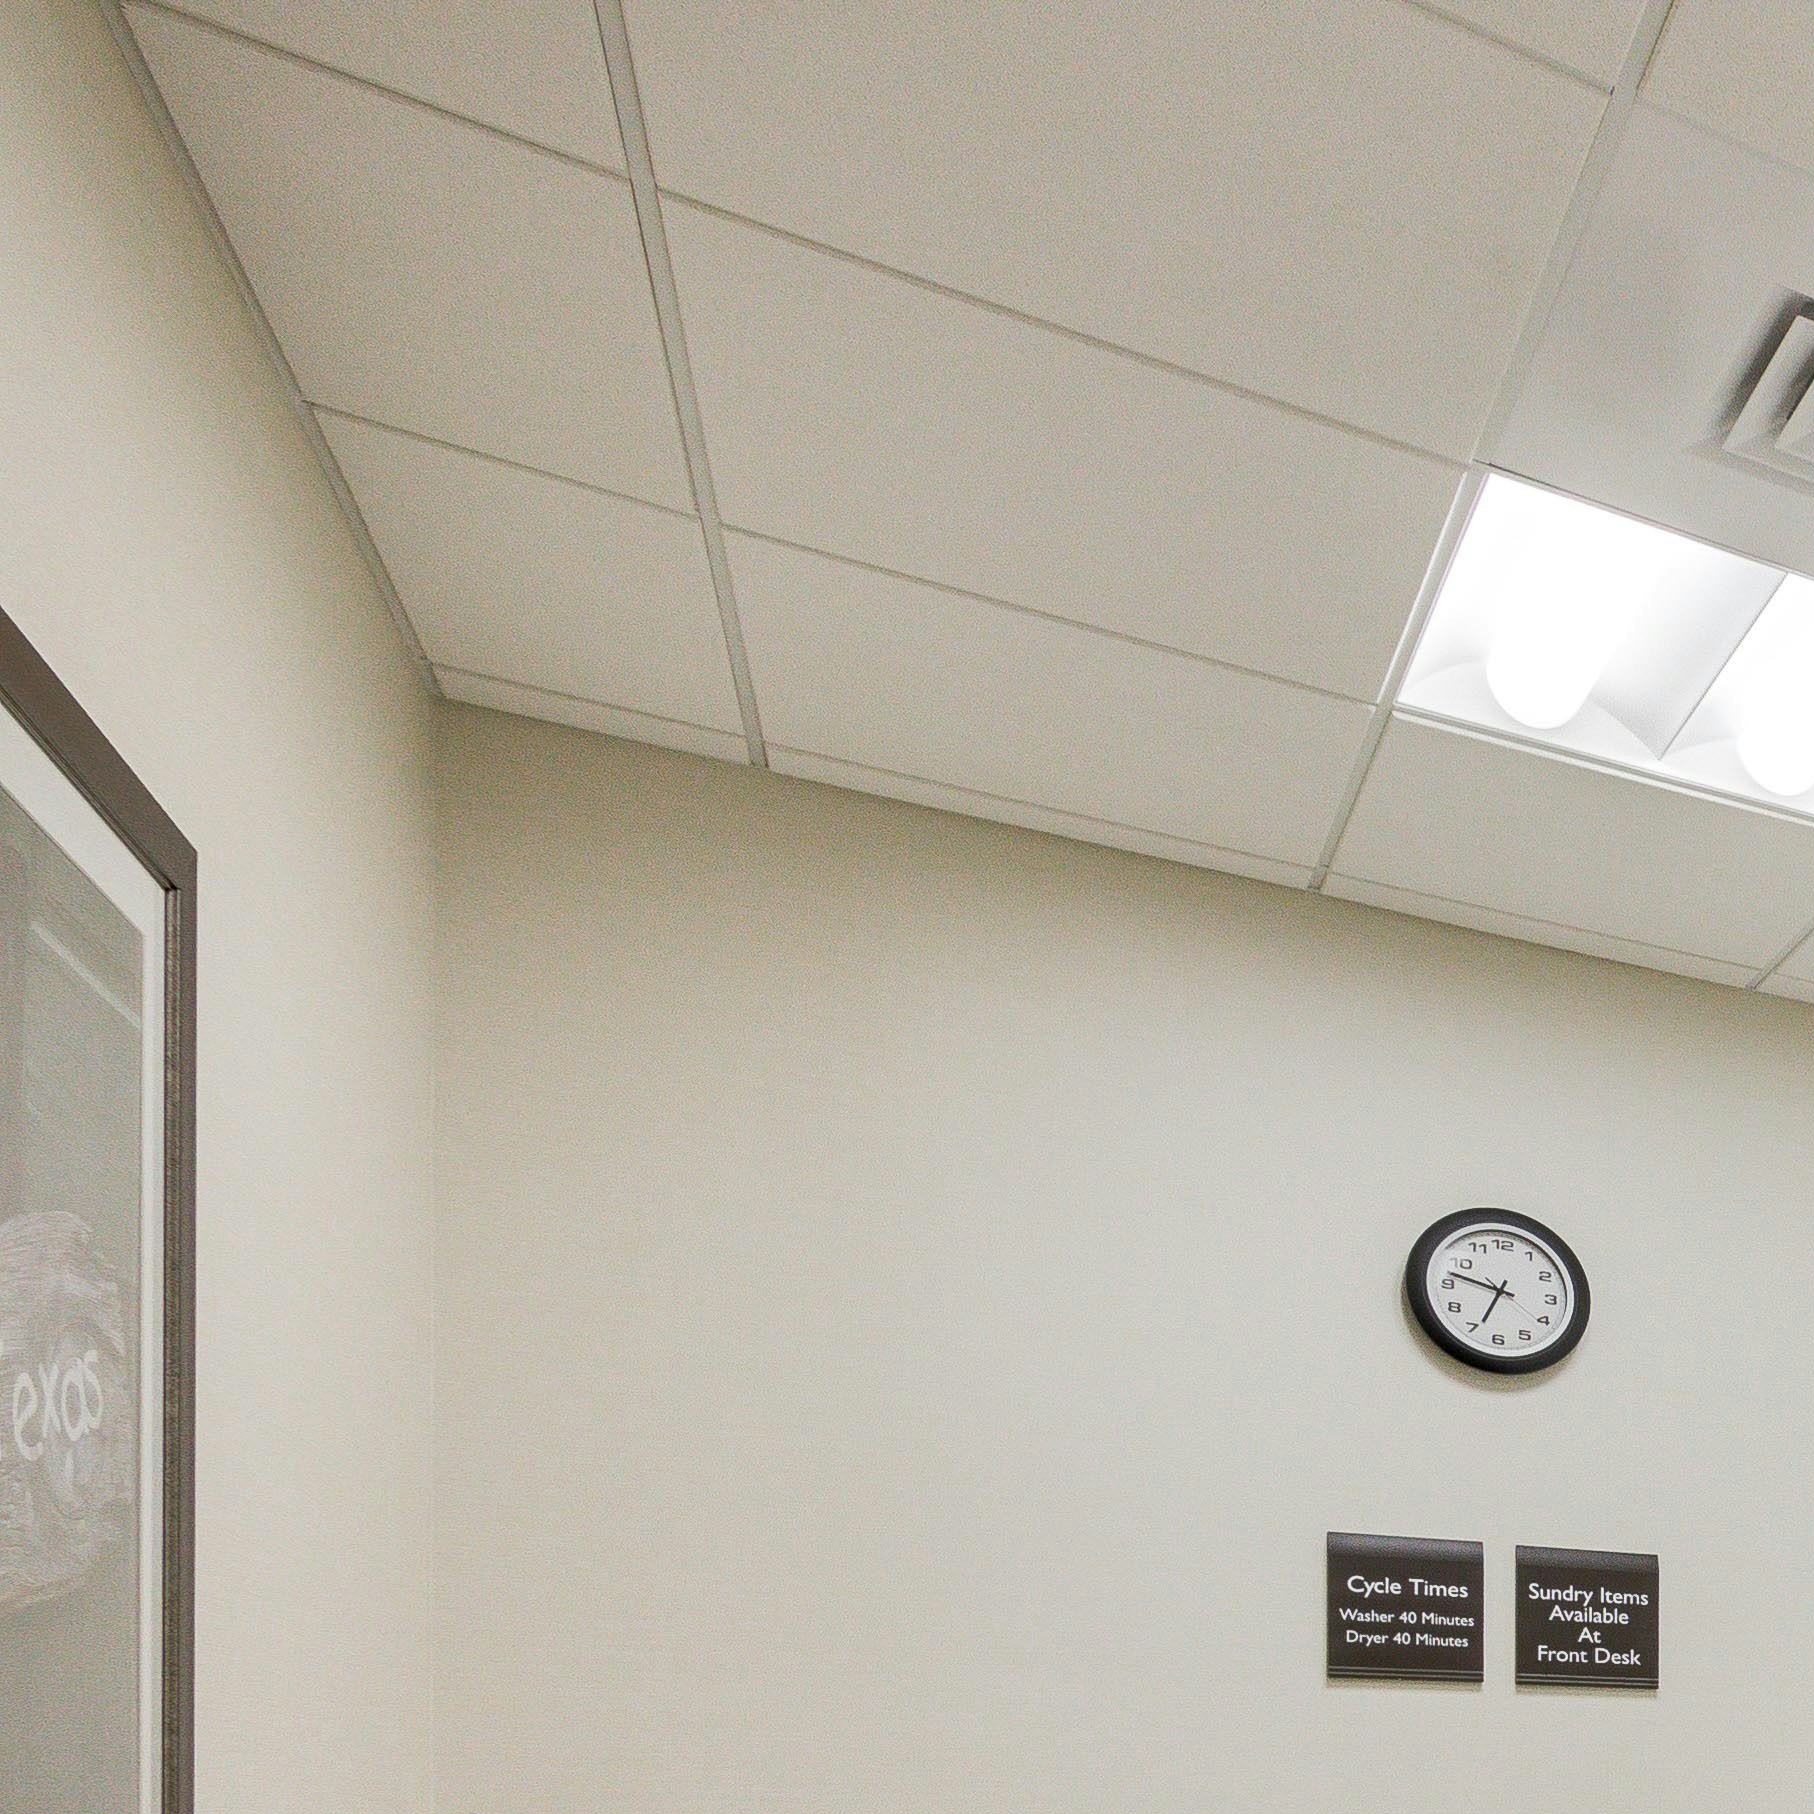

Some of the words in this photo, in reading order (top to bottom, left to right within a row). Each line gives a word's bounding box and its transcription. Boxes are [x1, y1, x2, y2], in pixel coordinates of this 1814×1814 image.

[1469, 1242, 1487, 1254] 11
[1492, 1239, 1514, 1252] 12
[1525, 1251, 1534, 1261] 1
[1452, 1258, 1472, 1269] 10
[1539, 1271, 1551, 1282] 2
[1442, 1279, 1455, 1289] 9
[1545, 1294, 1557, 1305] 3
[1448, 1302, 1461, 1313] 8
[1537, 1315, 1550, 1326] 4
[1466, 1322, 1479, 1332] 7
[1492, 1334, 1505, 1345] 6
[1518, 1330, 1532, 1341] 5
[0, 1340, 103, 1461] exas
[1347, 1575, 1402, 1597] Cycle
[1409, 1579, 1469, 1598] Times
[1528, 1583, 1593, 1605] Sundry
[1600, 1588, 1649, 1606] Items
[1339, 1608, 1394, 1623] Washer
[1399, 1612, 1417, 1624] 40
[1421, 1613, 1475, 1627] Minutes
[1549, 1605, 1629, 1624] Available
[1346, 1631, 1389, 1647] Dryer
[1393, 1633, 1411, 1645] 40
[1415, 1634, 1469, 1648] Minutes
[1578, 1628, 1601, 1644] At
[1538, 1646, 1588, 1663] Front
[1595, 1648, 1641, 1666] Desk
